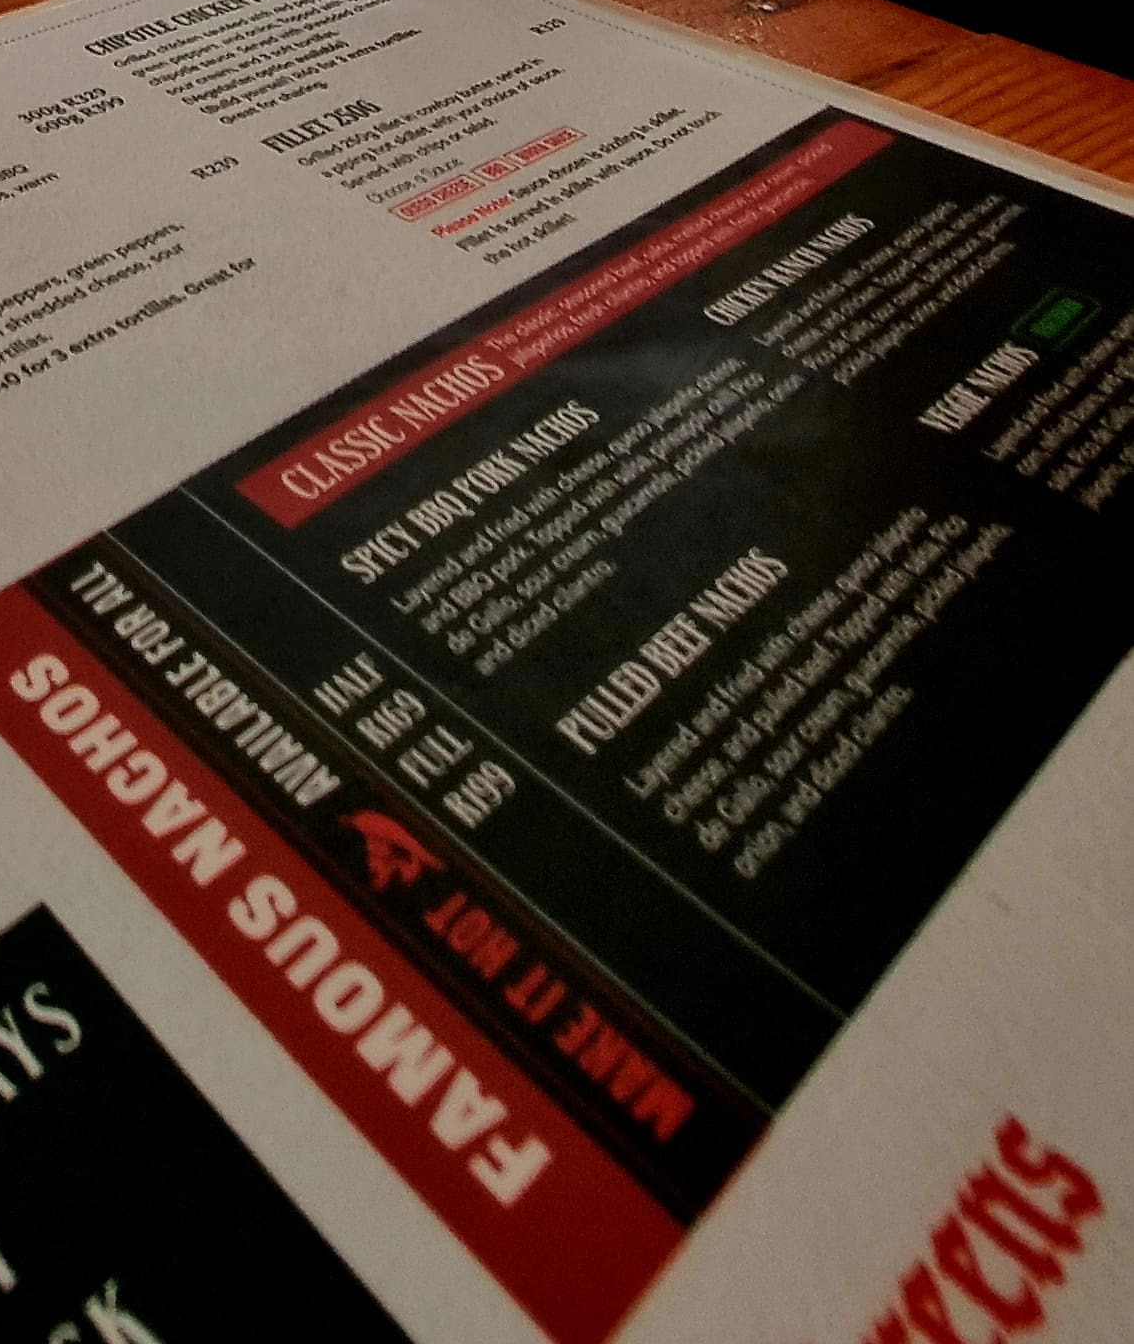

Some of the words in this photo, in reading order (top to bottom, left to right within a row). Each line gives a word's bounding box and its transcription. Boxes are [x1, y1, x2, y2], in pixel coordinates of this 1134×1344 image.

[83, 19, 178, 56] CHIPOTLE
[34, 113, 85, 133] 600g
[77, 96, 124, 117] R399
[259, 117, 334, 154] FILLET
[322, 98, 382, 127] 250G
[280, 415, 406, 499] CLASSIC
[388, 354, 505, 431] NACHOS
[340, 521, 421, 584] SPICY
[405, 490, 475, 537] BBQ
[451, 448, 527, 504] PORK
[508, 399, 599, 463] NACHOS
[70, 561, 133, 614] ALL
[113, 603, 185, 664] FOR
[556, 660, 660, 754] PULLED
[638, 611, 711, 677] BEEF
[689, 546, 788, 629] NACHOS
[313, 651, 383, 714] HALF
[165, 650, 340, 806] AVAILABLE
[355, 688, 425, 749] R169
[9, 653, 245, 885] NACHOS
[398, 724, 472, 787] FULL
[442, 760, 515, 828] R199
[424, 892, 518, 978] HOT
[504, 964, 565, 1021] IT
[227, 874, 549, 1204] FAMOUS
[555, 1004, 692, 1139] MAKE
